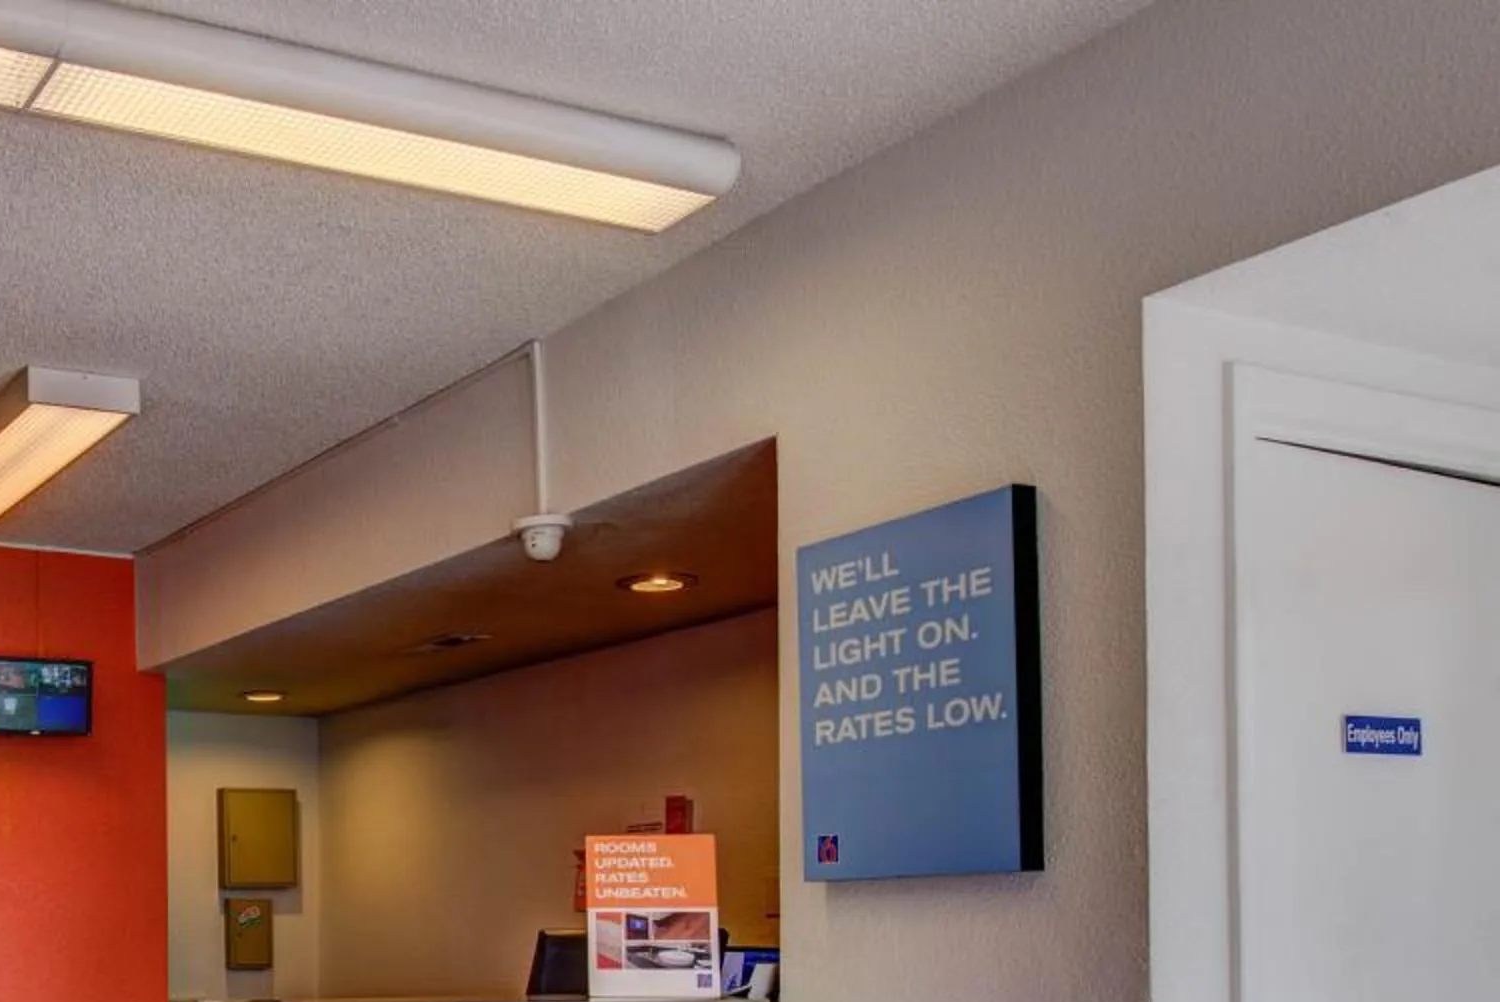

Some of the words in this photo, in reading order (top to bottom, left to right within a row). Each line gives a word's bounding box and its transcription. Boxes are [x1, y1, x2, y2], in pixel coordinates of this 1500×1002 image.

[811, 552, 899, 595] WE'LL
[813, 587, 911, 634] LEAVE
[920, 567, 992, 608] THE
[814, 628, 906, 671] LIGHT
[917, 614, 979, 650] ON.
[814, 673, 882, 709] AND
[893, 659, 962, 695] THE
[815, 706, 916, 746] RATES
[927, 692, 1008, 731] LOW.
[1347, 723, 1396, 749] Employees
[1397, 726, 1418, 751] Only
[594, 841, 658, 854] ROOMS
[594, 856, 675, 869] UPDATED.
[594, 872, 649, 884] RATES
[594, 886, 688, 899] UNBEATEN.
